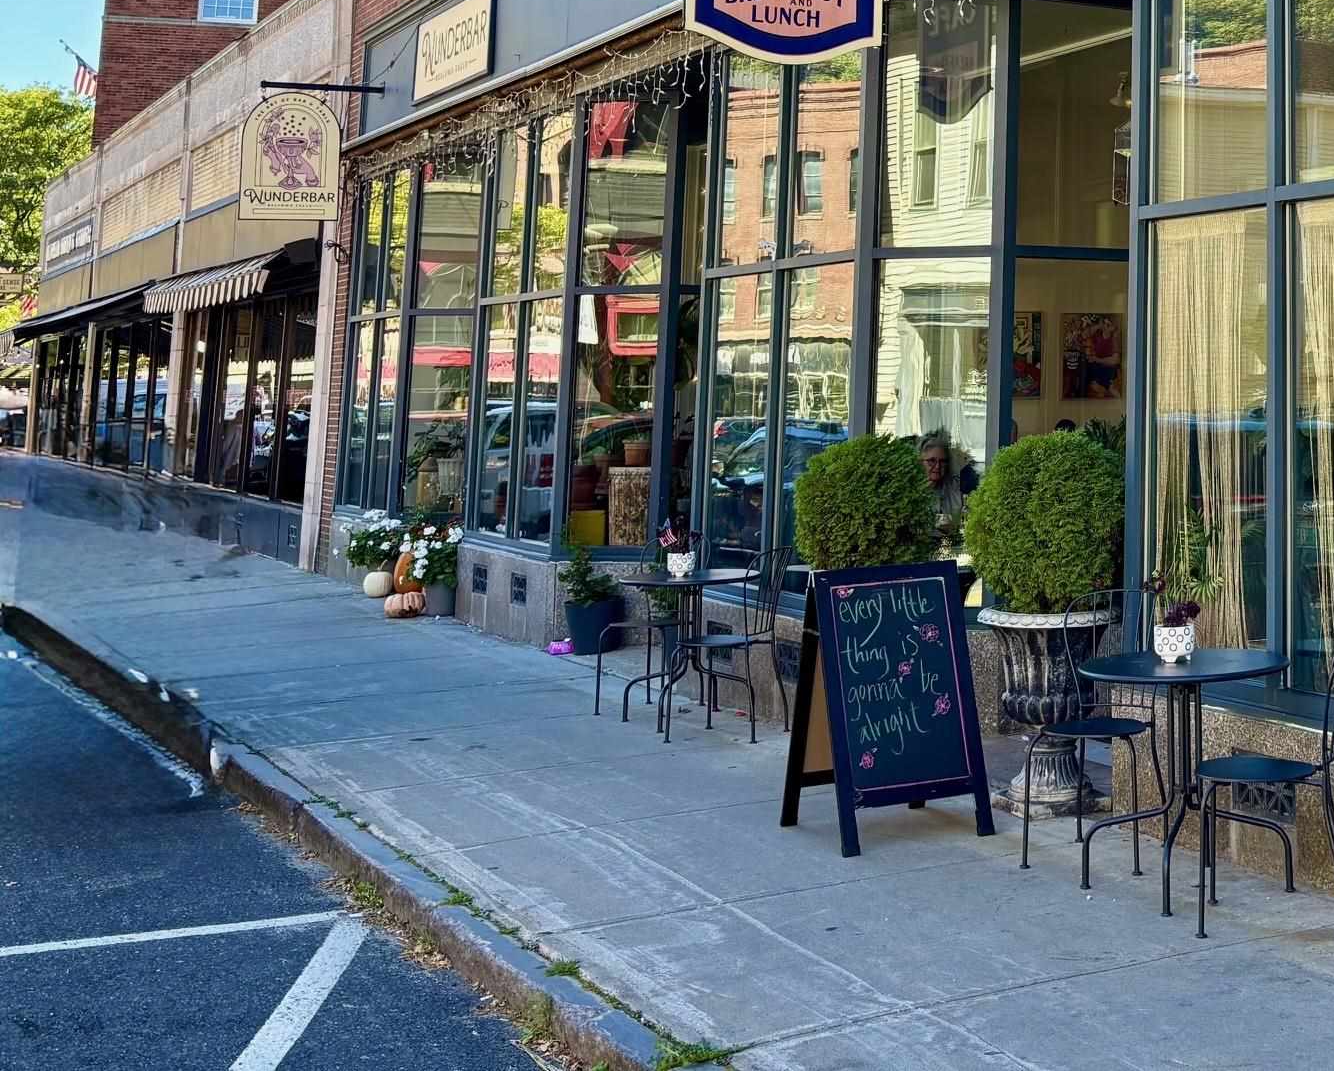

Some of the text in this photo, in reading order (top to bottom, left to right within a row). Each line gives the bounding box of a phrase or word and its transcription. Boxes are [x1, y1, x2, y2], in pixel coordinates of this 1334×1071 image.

[751, 4, 820, 28] LUNCH
[421, 9, 488, 79] WUNDERBAR
[243, 188, 336, 205] WUNDERBAR
[839, 593, 883, 648] every
[840, 630, 920, 680] thing is
[847, 657, 943, 722] gonna be
[859, 700, 929, 755] alright
